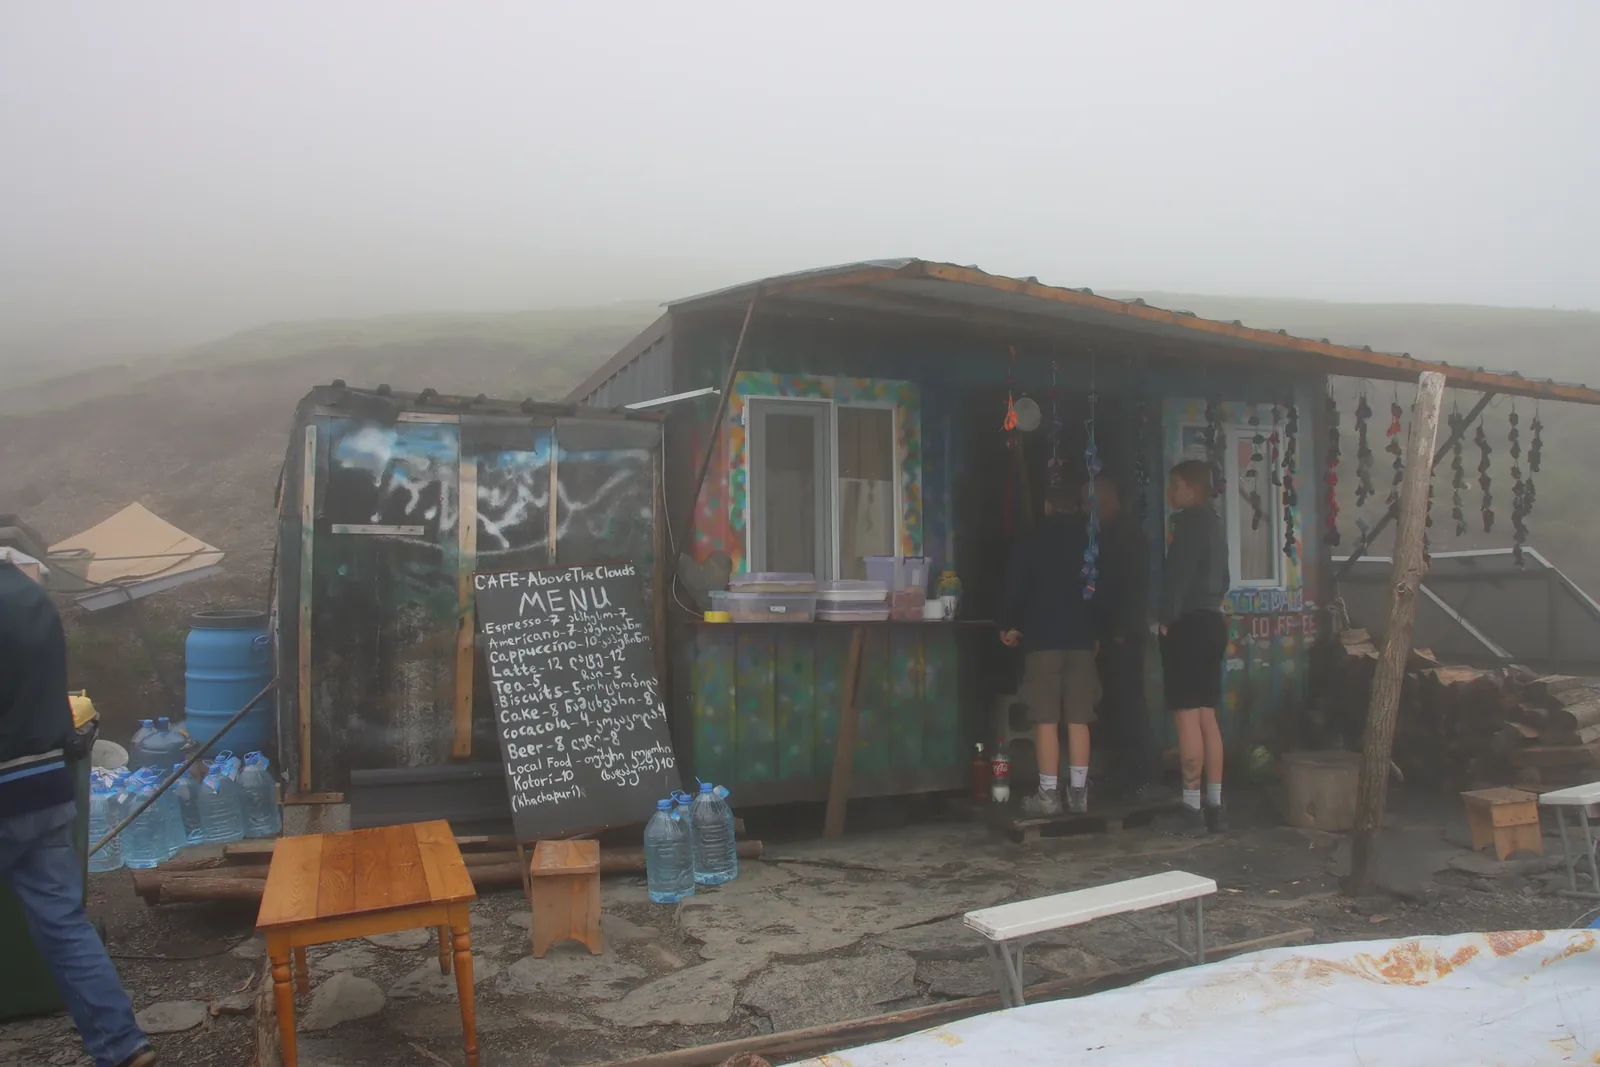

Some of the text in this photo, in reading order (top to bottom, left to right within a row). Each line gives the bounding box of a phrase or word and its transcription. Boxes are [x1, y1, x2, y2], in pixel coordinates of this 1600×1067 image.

[519, 586, 612, 617] MENU
[507, 757, 543, 776] Local
[547, 752, 572, 769] Food
